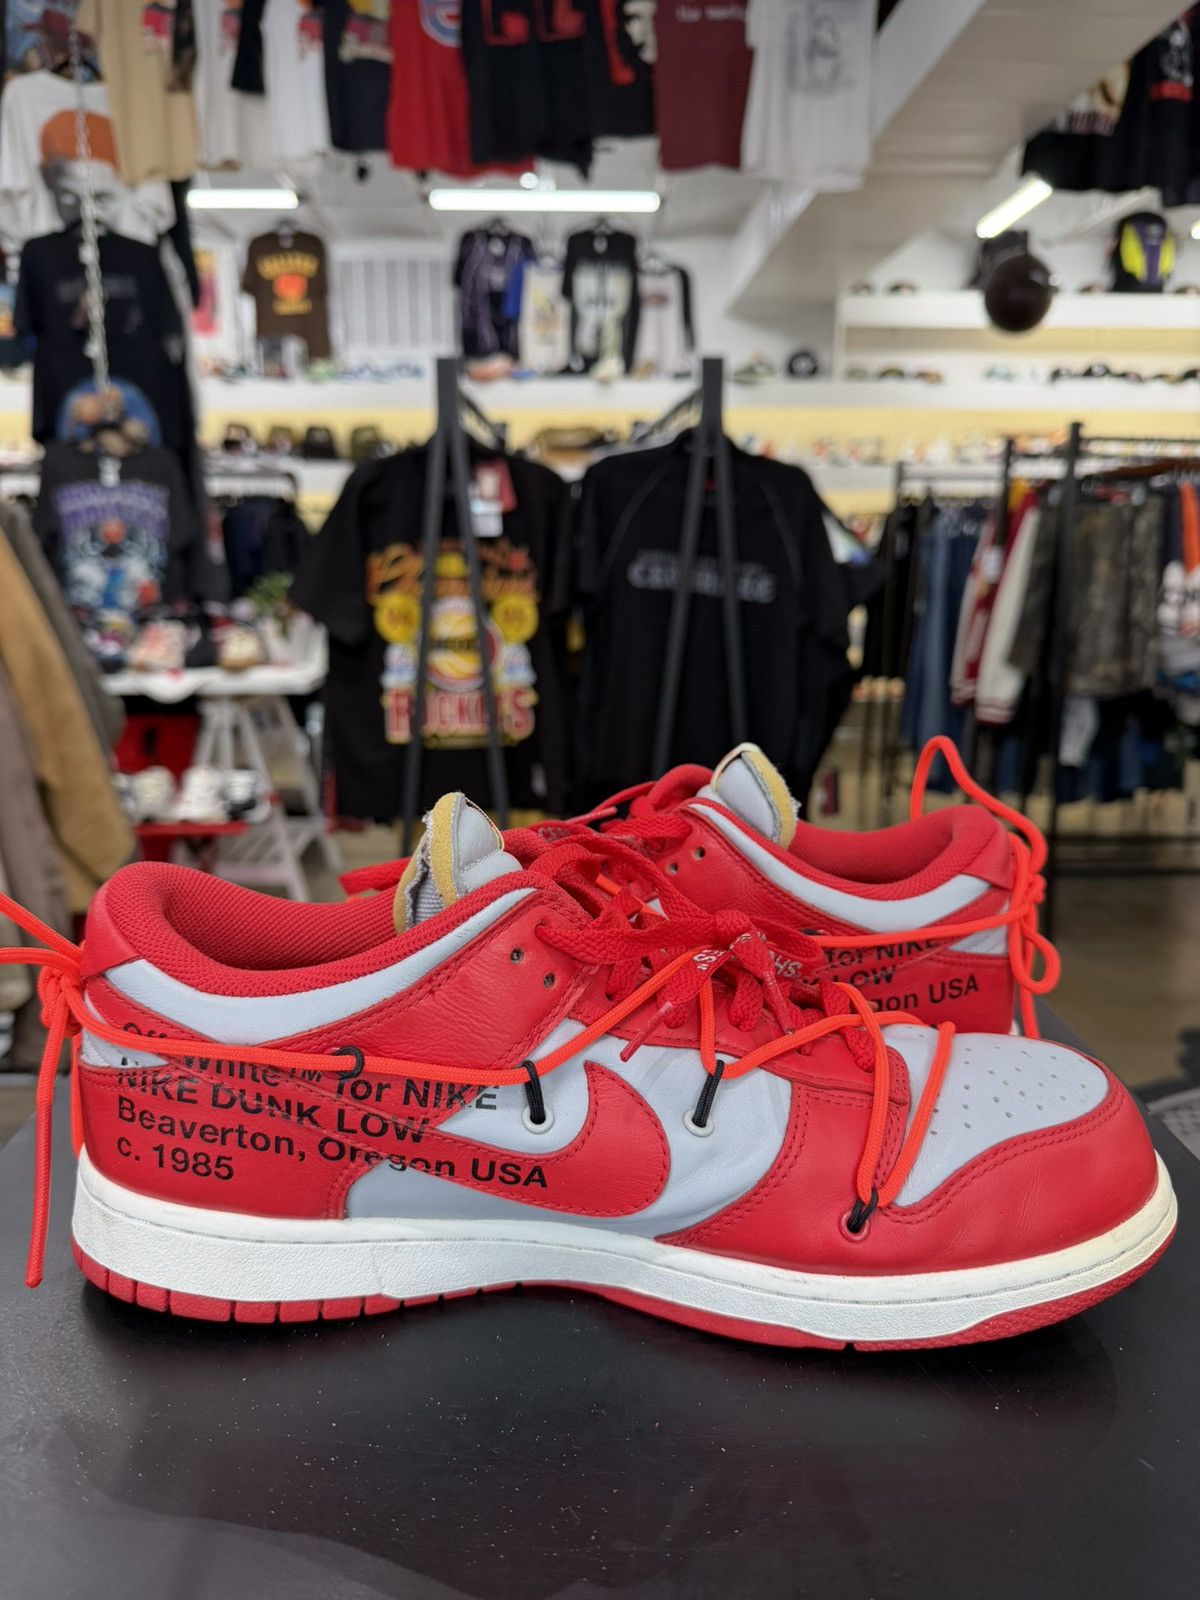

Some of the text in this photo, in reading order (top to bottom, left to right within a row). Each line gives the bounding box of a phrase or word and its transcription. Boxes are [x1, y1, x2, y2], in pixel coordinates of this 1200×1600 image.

[928, 974, 979, 1004] USA
[117, 1056, 430, 1144] NIKE DUNK LOW
[402, 1077, 500, 1110] NIKE
[117, 1095, 549, 1189] Beaverton, Oregon USA
[117, 1136, 235, 1181] c. 1985
